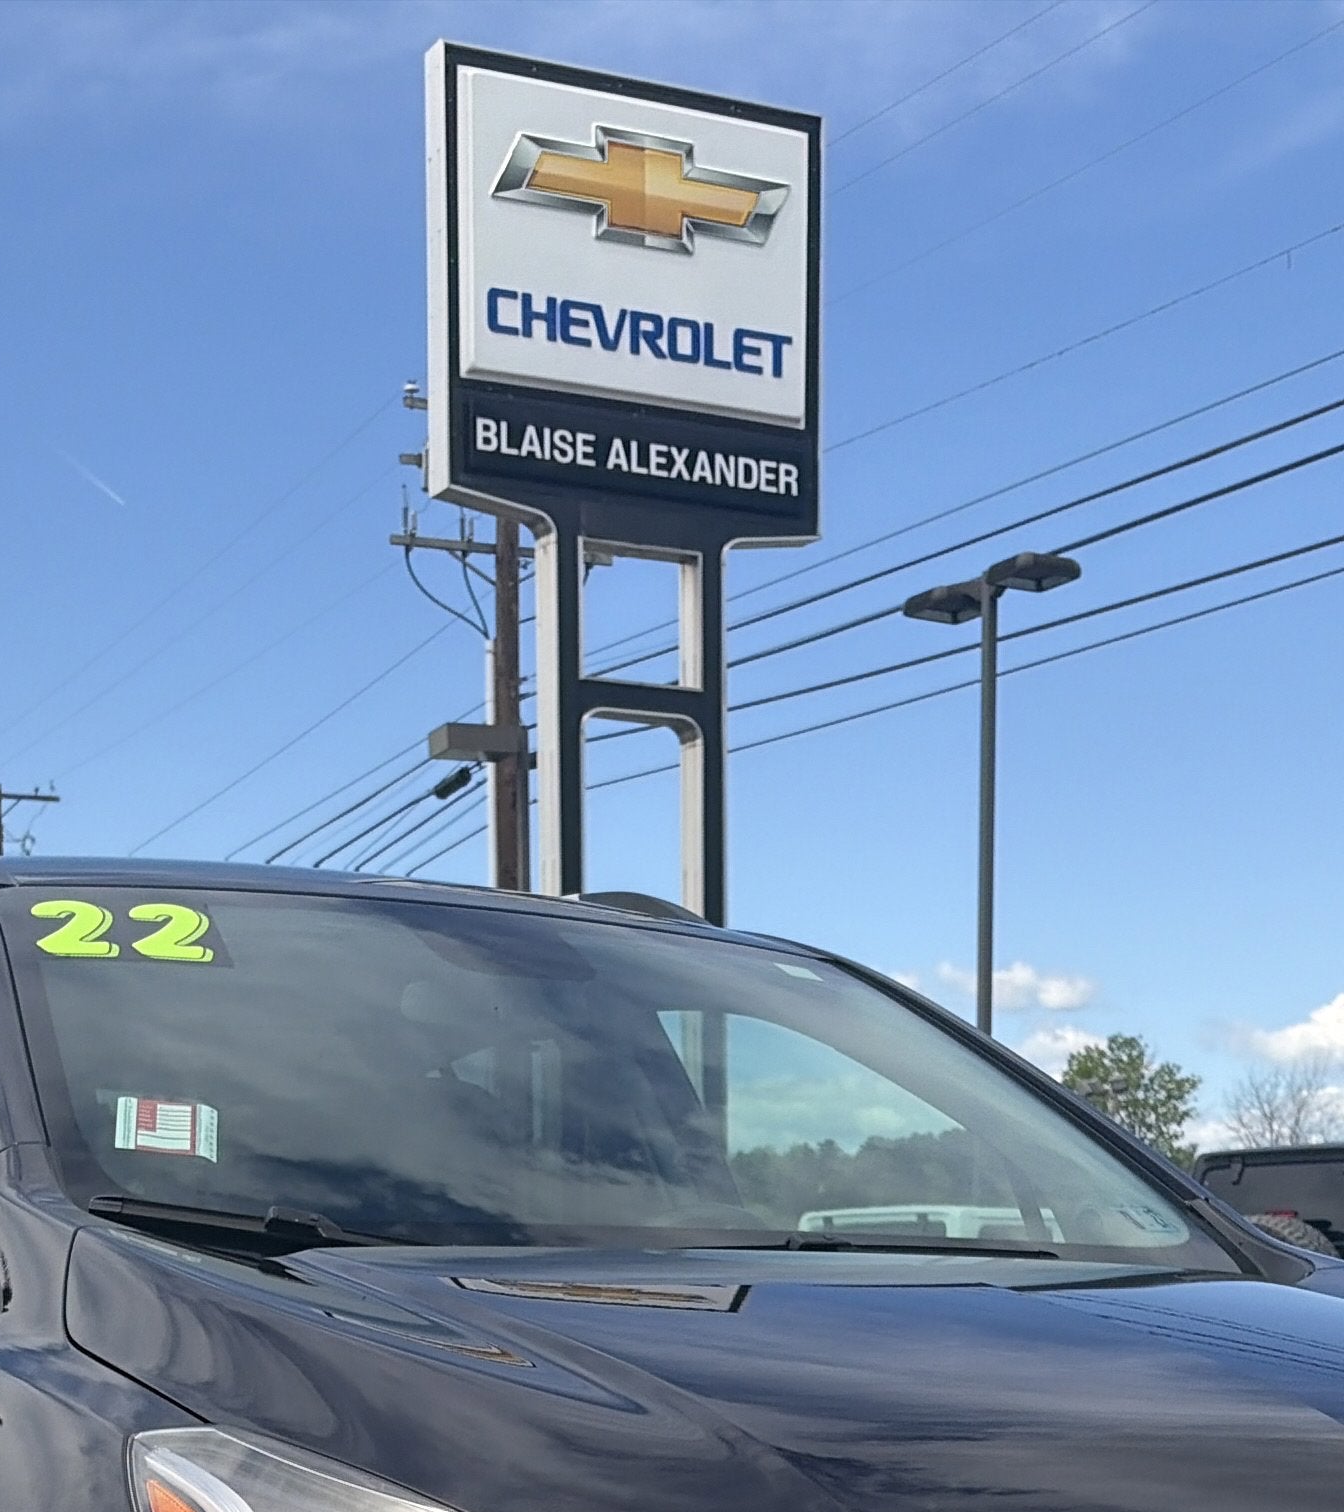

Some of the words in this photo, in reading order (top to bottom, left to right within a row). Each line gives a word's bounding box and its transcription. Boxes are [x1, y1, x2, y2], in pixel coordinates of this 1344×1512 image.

[486, 287, 793, 378] CHEVROLET
[475, 416, 596, 468] BLAISE
[606, 438, 800, 497] ALEXANDER
[31, 899, 215, 962] 22
